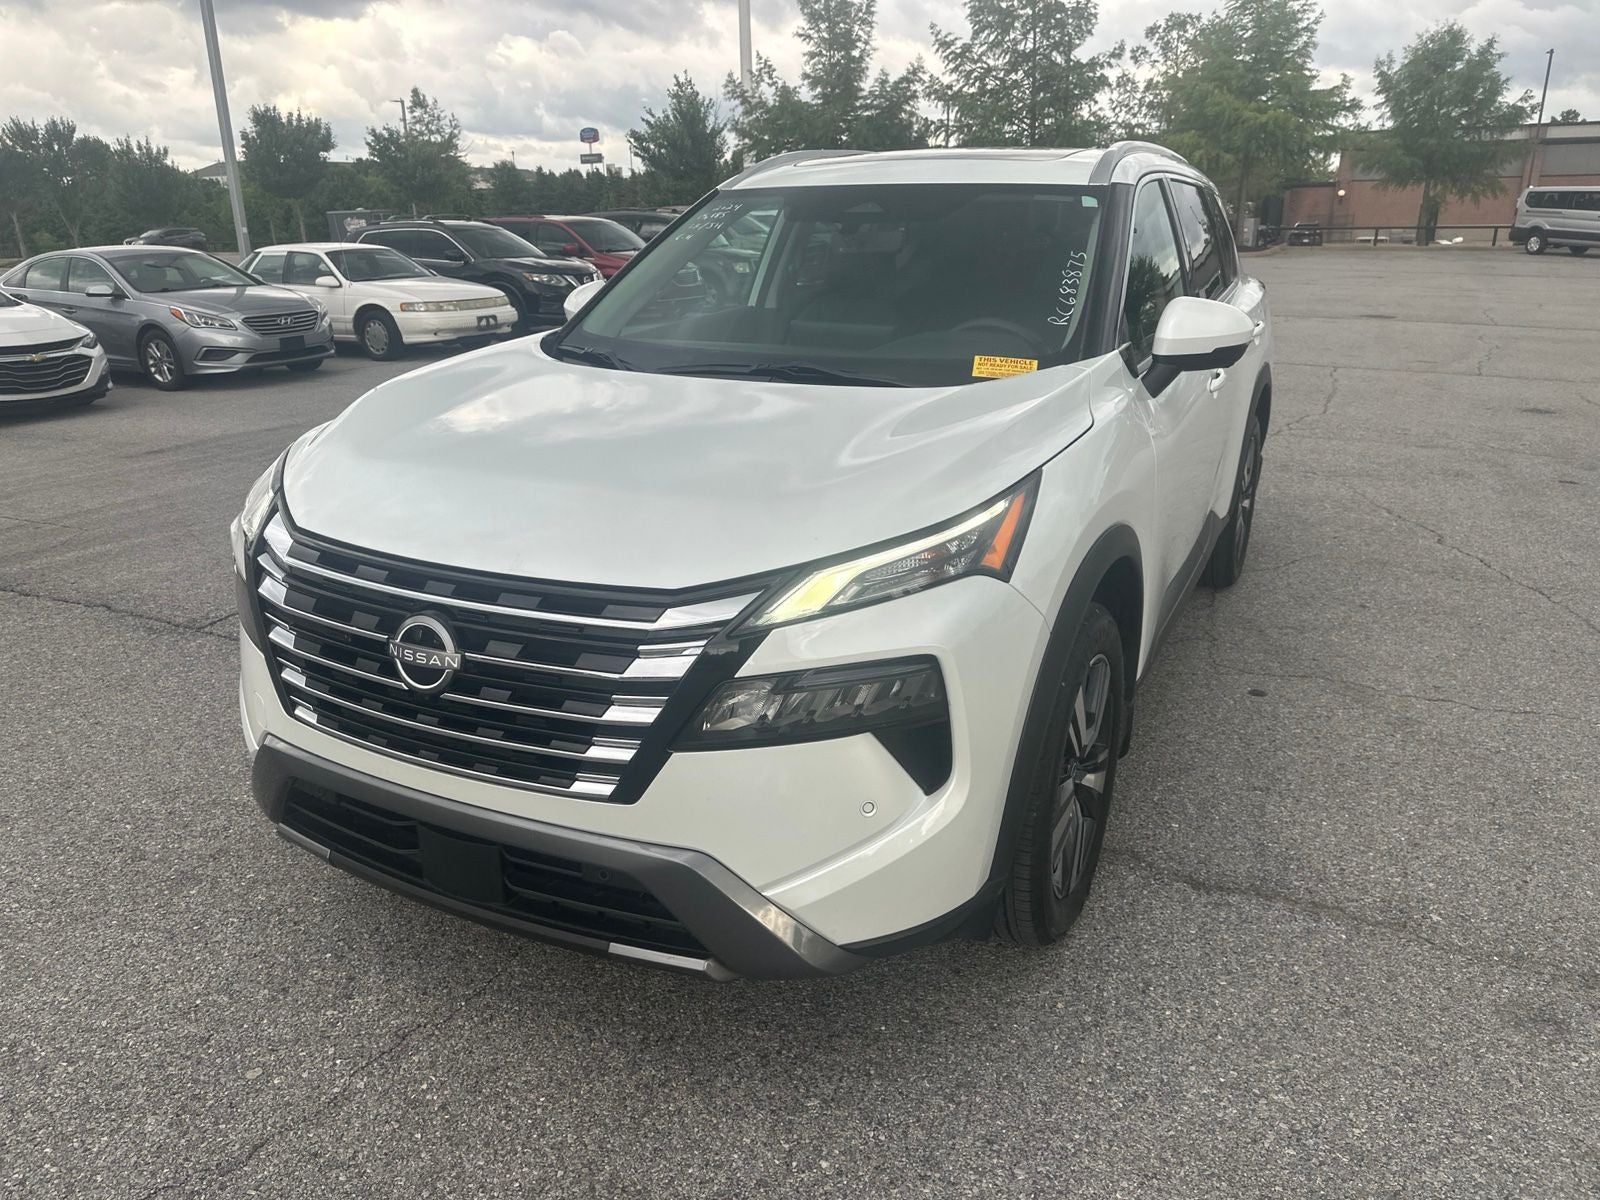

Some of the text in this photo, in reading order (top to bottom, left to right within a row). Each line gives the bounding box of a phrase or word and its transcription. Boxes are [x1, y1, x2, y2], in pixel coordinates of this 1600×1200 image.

[1047, 250, 1087, 325] RC683875
[999, 358, 1034, 366] VEHICLE
[389, 643, 458, 668] NISSAN
